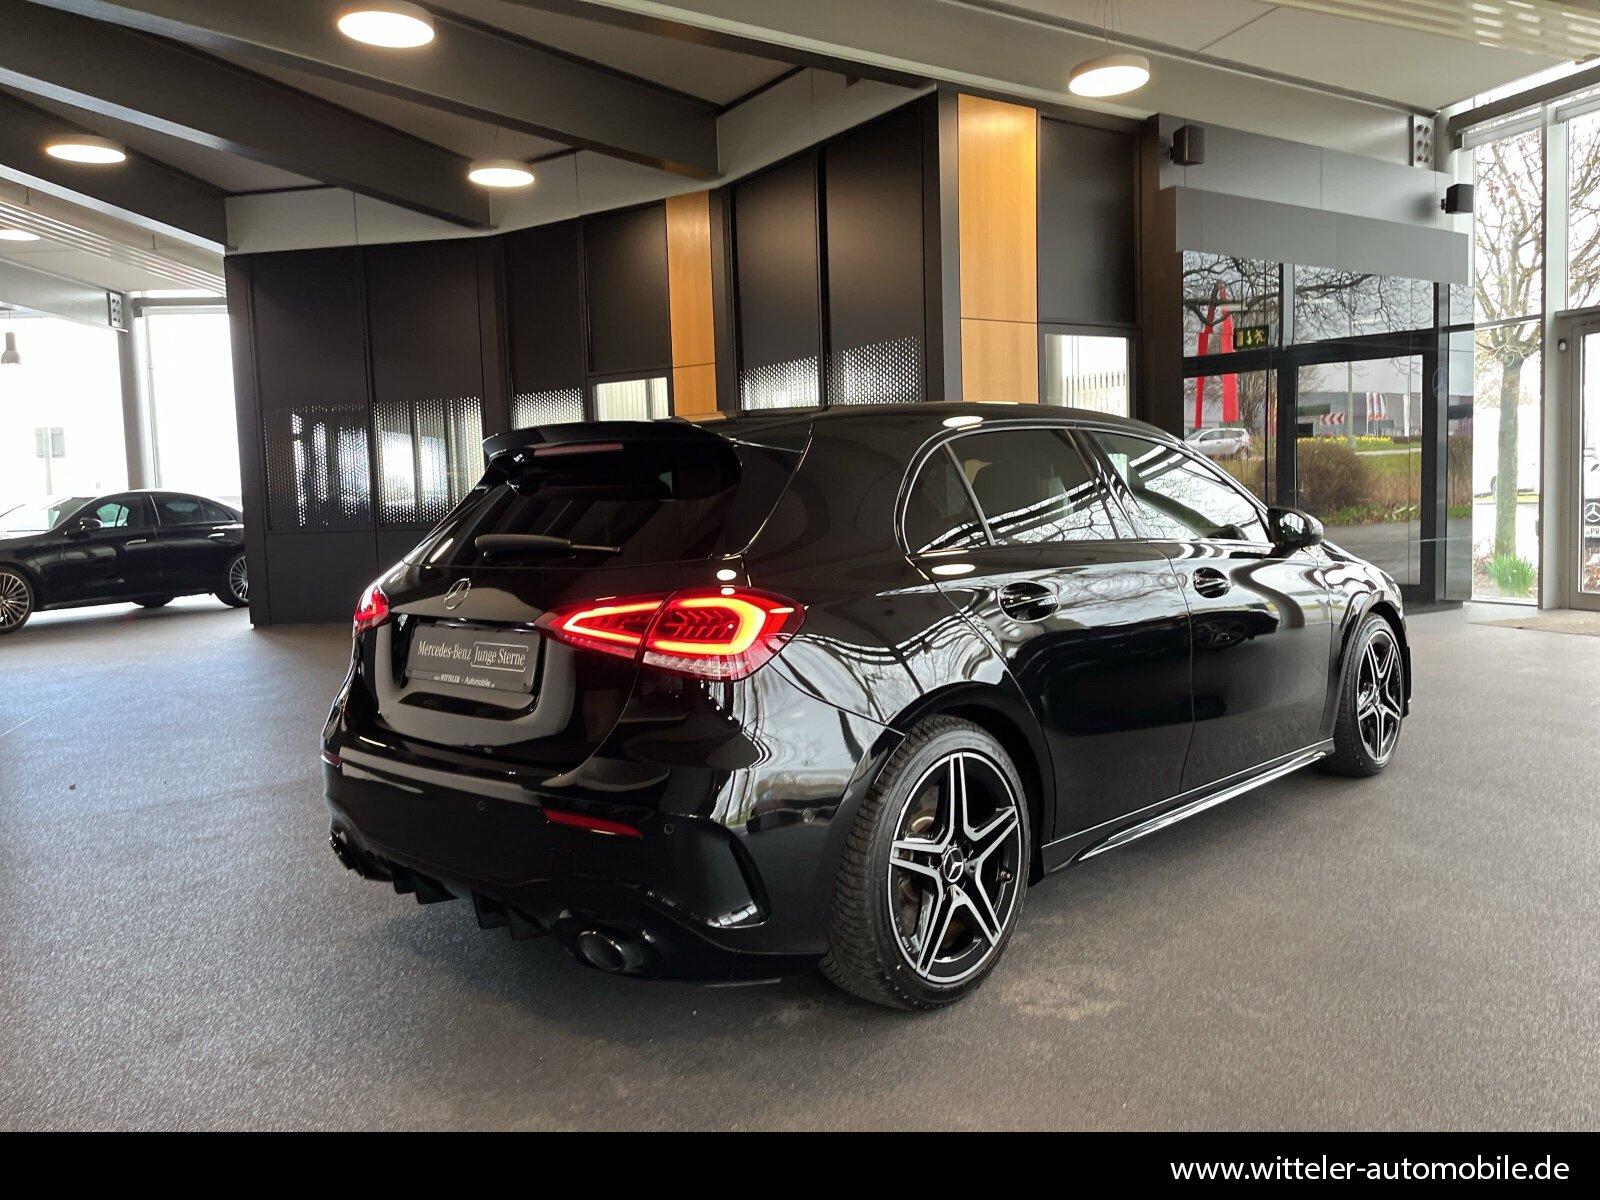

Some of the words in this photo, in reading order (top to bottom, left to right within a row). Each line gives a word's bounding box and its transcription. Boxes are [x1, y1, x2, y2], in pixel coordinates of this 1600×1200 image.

[417, 640, 472, 660] Mercedes-Benz
[473, 645, 497, 665] Junge
[497, 647, 526, 666] Sterne
